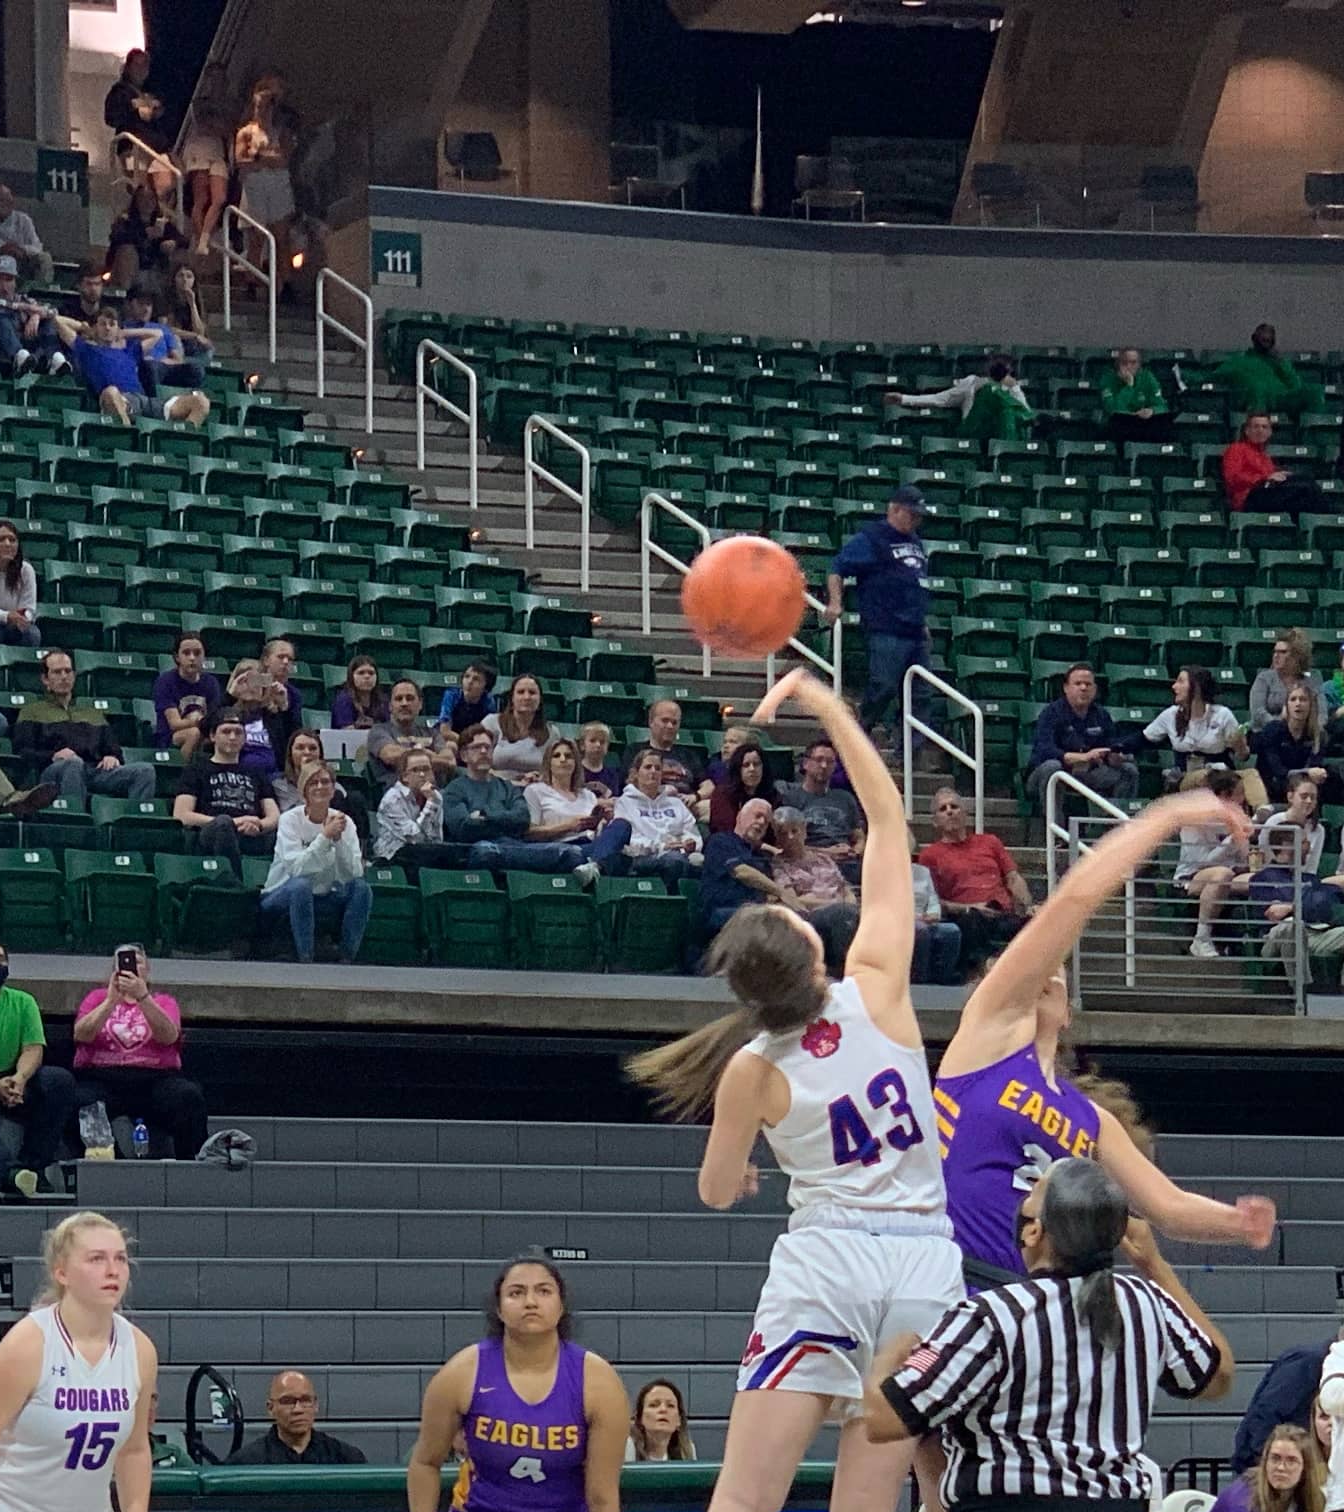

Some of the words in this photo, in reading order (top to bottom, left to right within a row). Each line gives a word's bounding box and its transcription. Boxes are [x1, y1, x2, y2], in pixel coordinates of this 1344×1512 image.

[47, 168, 78, 193] 111
[383, 250, 411, 272] 111
[828, 1067, 924, 1168] 43
[54, 1387, 130, 1412] COUGARS
[64, 1421, 121, 1471] 15
[474, 1415, 579, 1451] EAGLES
[509, 1455, 547, 1484] 4
